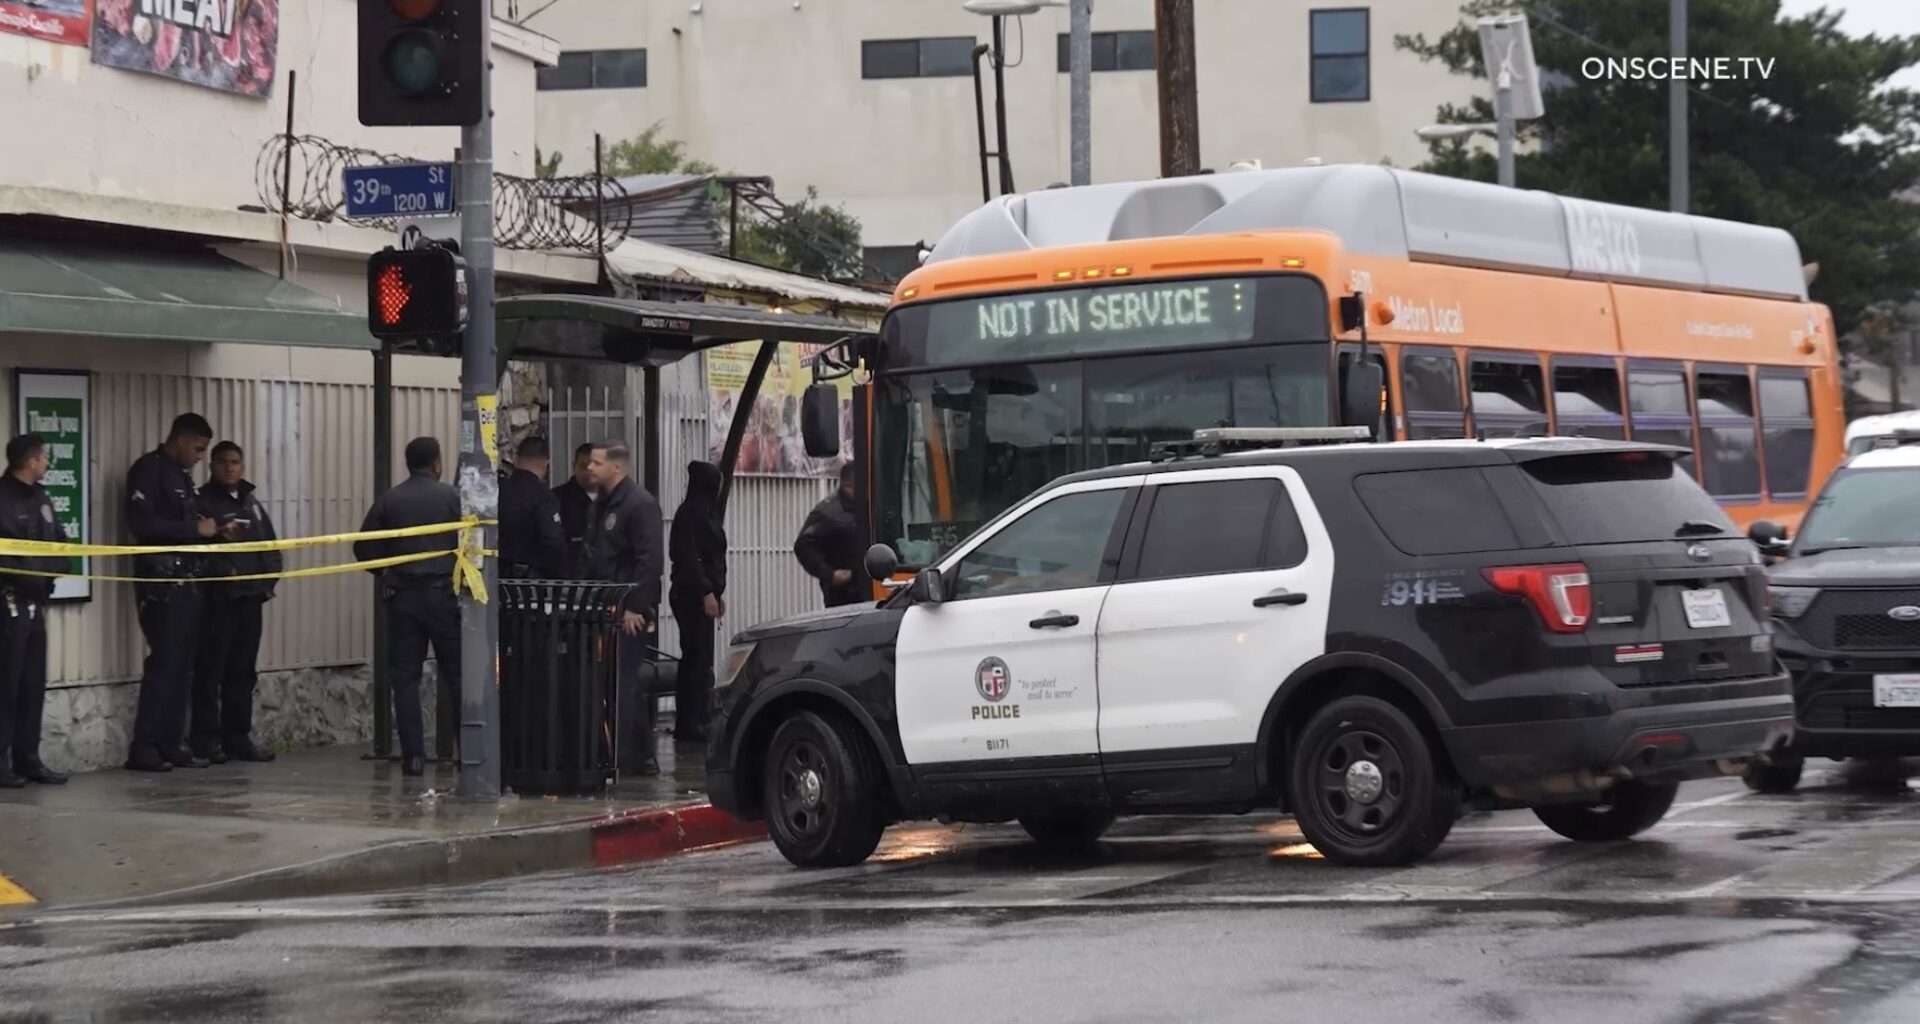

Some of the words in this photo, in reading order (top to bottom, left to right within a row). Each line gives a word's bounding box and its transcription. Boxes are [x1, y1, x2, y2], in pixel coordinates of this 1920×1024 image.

[428, 166, 445, 184] St
[352, 179, 392, 205] 39th
[393, 193, 427, 211] 1200
[433, 192, 446, 209] W
[1567, 203, 1641, 276] Metro
[977, 301, 1036, 340] NOT
[1046, 297, 1080, 335] IN
[1089, 287, 1211, 332] SERVICE
[1388, 296, 1429, 332] Metro
[1430, 298, 1464, 334] Local
[29, 410, 59, 433] Thank
[60, 416, 79, 438] you
[37, 468, 77, 489] siness,
[971, 704, 1020, 720] POLICE
